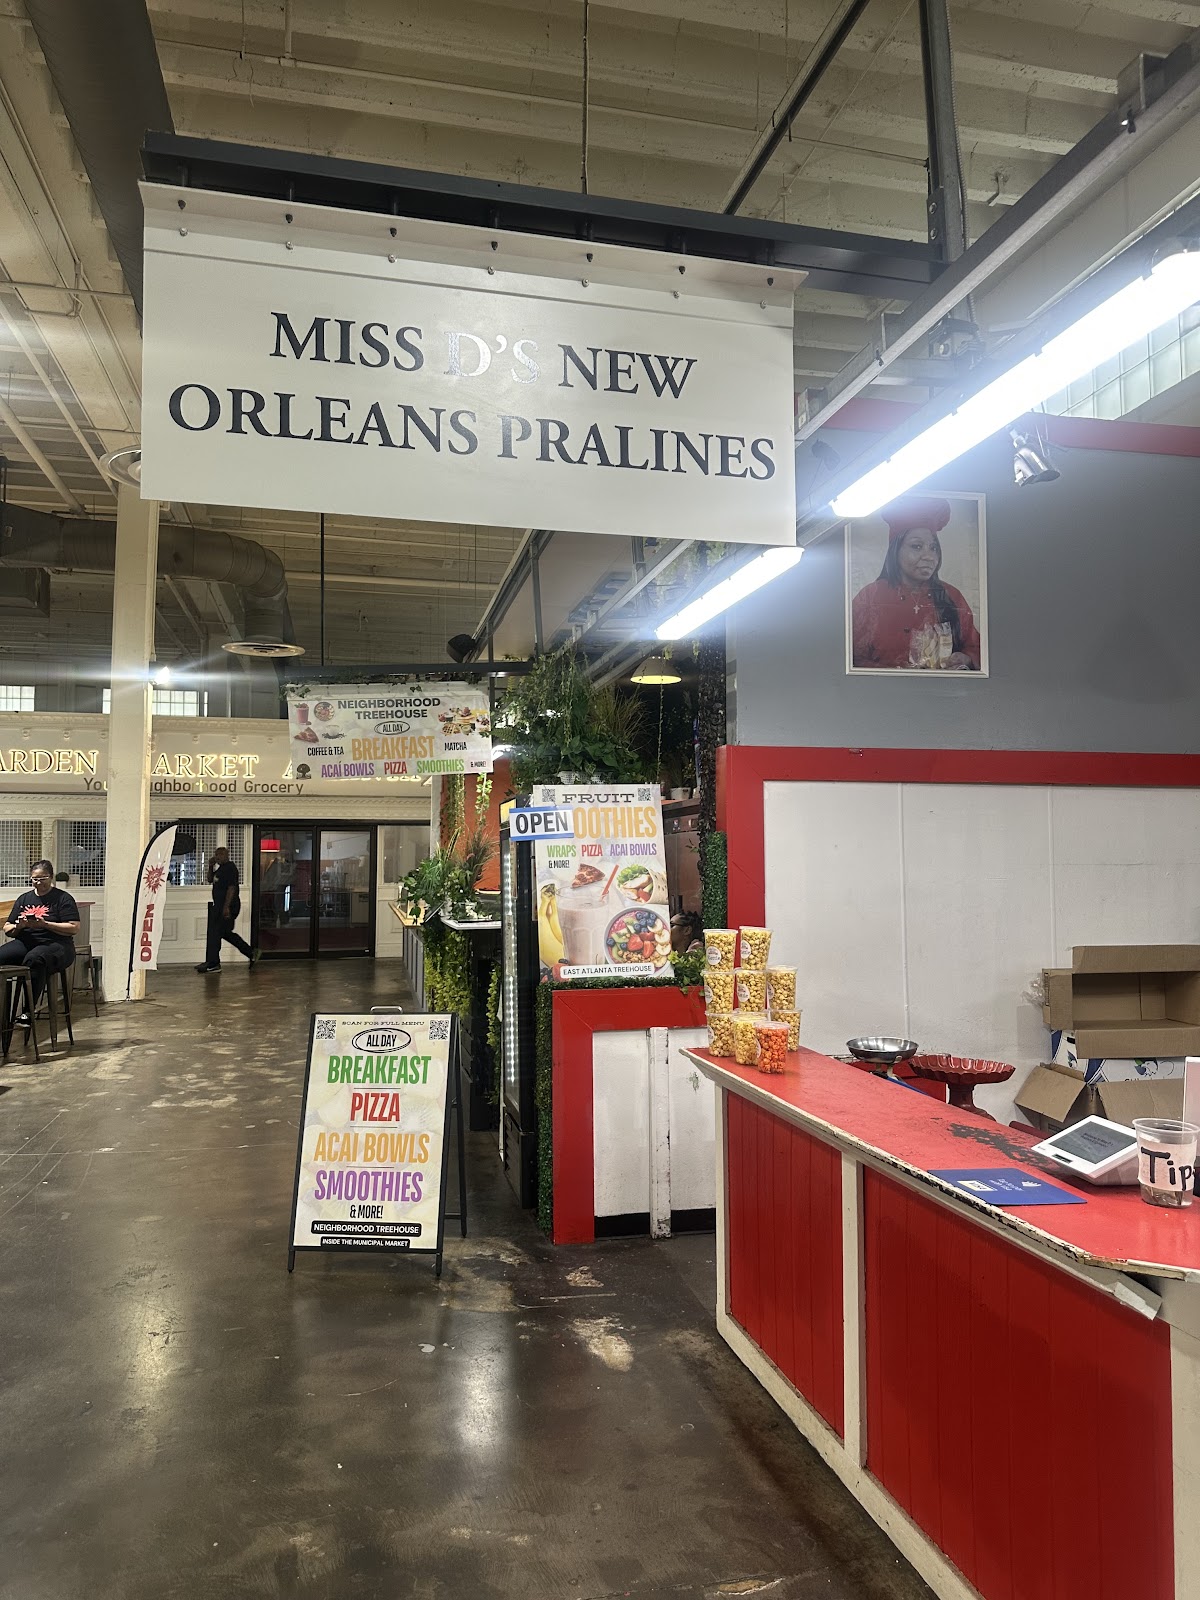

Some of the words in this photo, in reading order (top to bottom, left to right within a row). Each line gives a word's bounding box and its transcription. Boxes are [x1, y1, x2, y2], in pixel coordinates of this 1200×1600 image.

[270, 312, 423, 371] MISS
[559, 344, 697, 399] NEW
[168, 383, 478, 456] ORLEANS
[497, 414, 776, 480] PRALINES
[338, 698, 441, 709] NEIGHBORHOOD
[355, 709, 428, 720] TREEHOUSE
[382, 724, 392, 733] ALL
[393, 724, 404, 732] DAY
[307, 747, 327, 756] COFFEE
[328, 748, 333, 756] &
[333, 746, 345, 755] TEA
[351, 735, 435, 761] BREAKFAST
[444, 741, 467, 751] MATCHA
[151, 752, 259, 778] ARKET
[344, 762, 375, 777] BOWLS
[384, 761, 407, 775] PIZZA
[417, 759, 465, 774] SMOOTHIES
[244, 781, 304, 795] Grocery
[562, 794, 635, 804] FRUIT
[515, 811, 569, 834] OPEN
[573, 806, 657, 839] OOTHIES
[547, 845, 576, 858] WRAPS
[582, 844, 603, 857] PIZZA
[610, 843, 628, 856] ACAI
[630, 843, 657, 856] BOWLS
[548, 860, 553, 868] &
[553, 860, 570, 868] MORE!
[140, 903, 155, 962] OPEN
[581, 967, 612, 975] ATLANTA
[613, 965, 652, 973] TREEHOUSE
[366, 1035, 380, 1047] ALL
[381, 1034, 397, 1047] DAY
[327, 1055, 432, 1085] BREAKFAST
[350, 1092, 400, 1122] PIZZA
[313, 1132, 360, 1163] ACAI
[363, 1133, 430, 1164] BOWLS
[1140, 1146, 1195, 1191] Tip
[314, 1170, 423, 1202] SMOOTHIES
[350, 1204, 356, 1219] &
[357, 1204, 384, 1219] MORE!
[313, 1223, 375, 1233] NEIGHBORHOOD
[375, 1225, 419, 1234] TREEHOUSE
